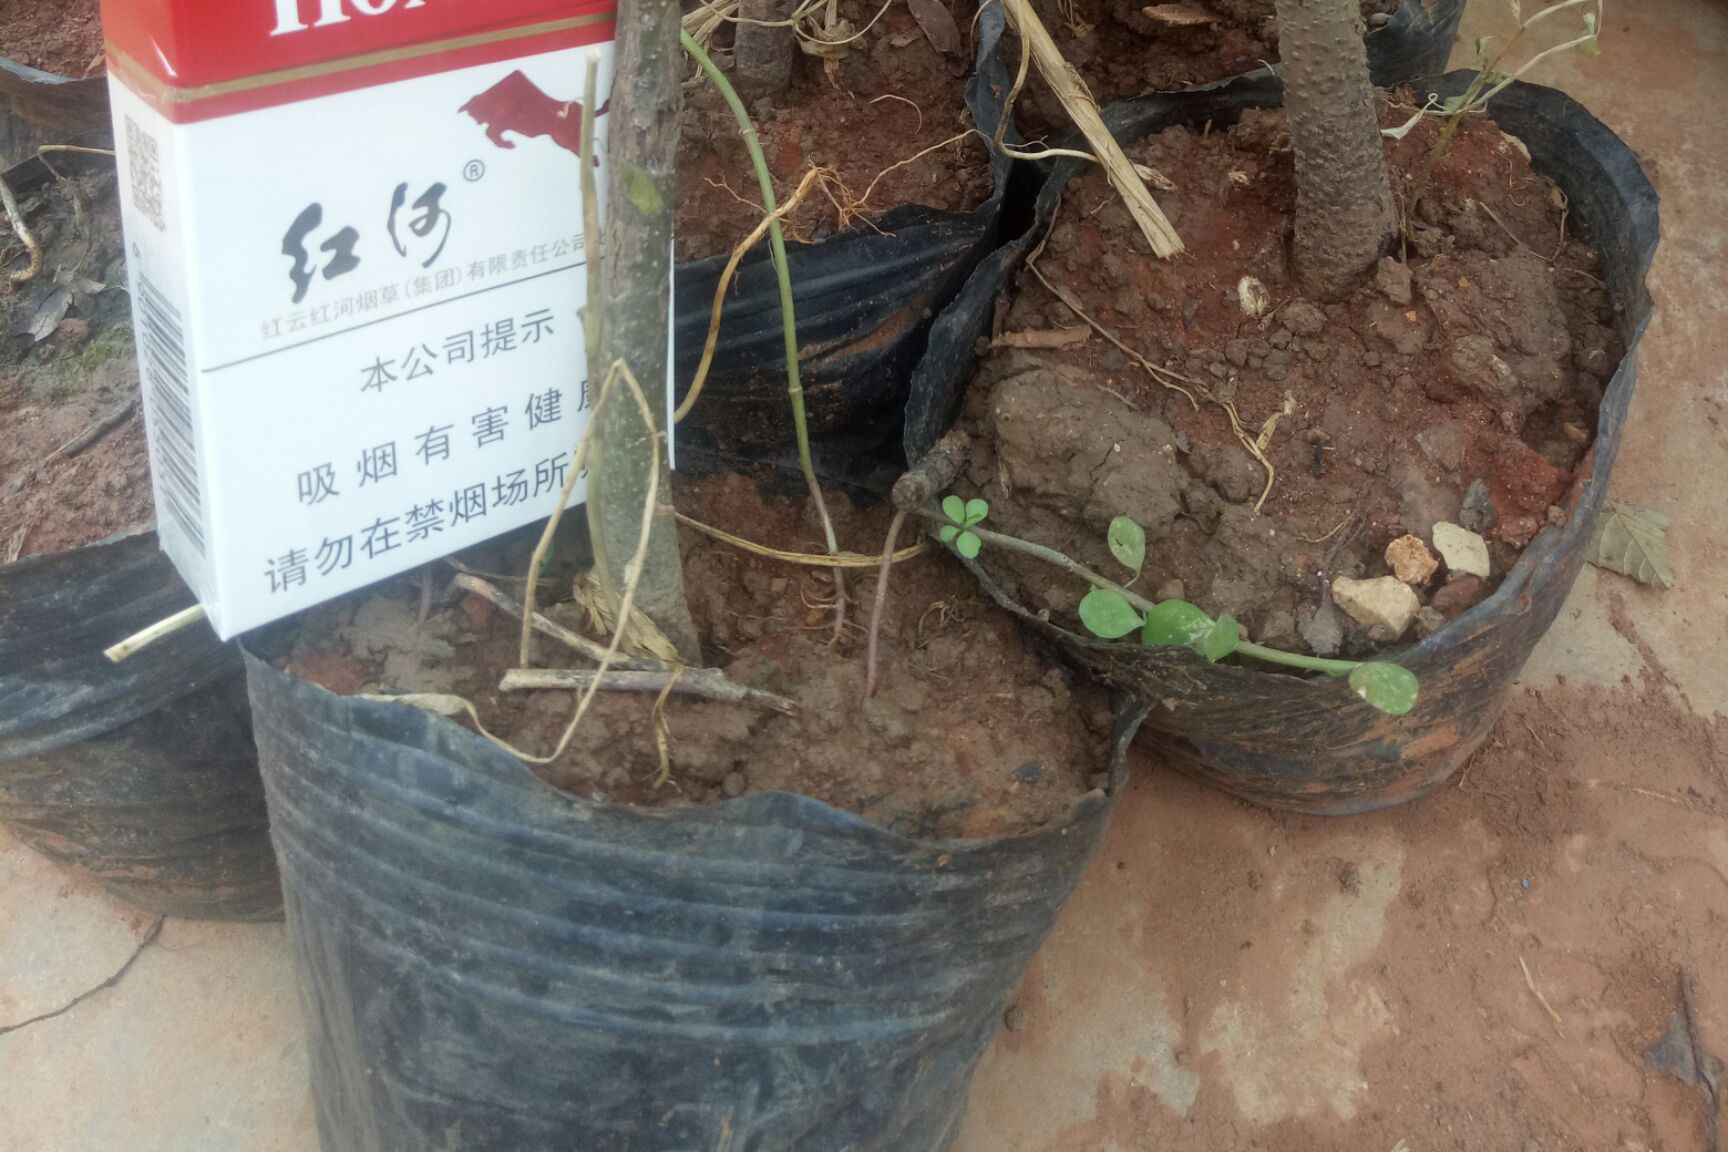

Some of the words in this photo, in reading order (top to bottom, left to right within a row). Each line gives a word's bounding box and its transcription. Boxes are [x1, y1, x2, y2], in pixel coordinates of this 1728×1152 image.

[281, 181, 452, 305] 红河
[360, 308, 555, 395] 本公司提示
[264, 448, 589, 595] 请勿在禁烟场所
